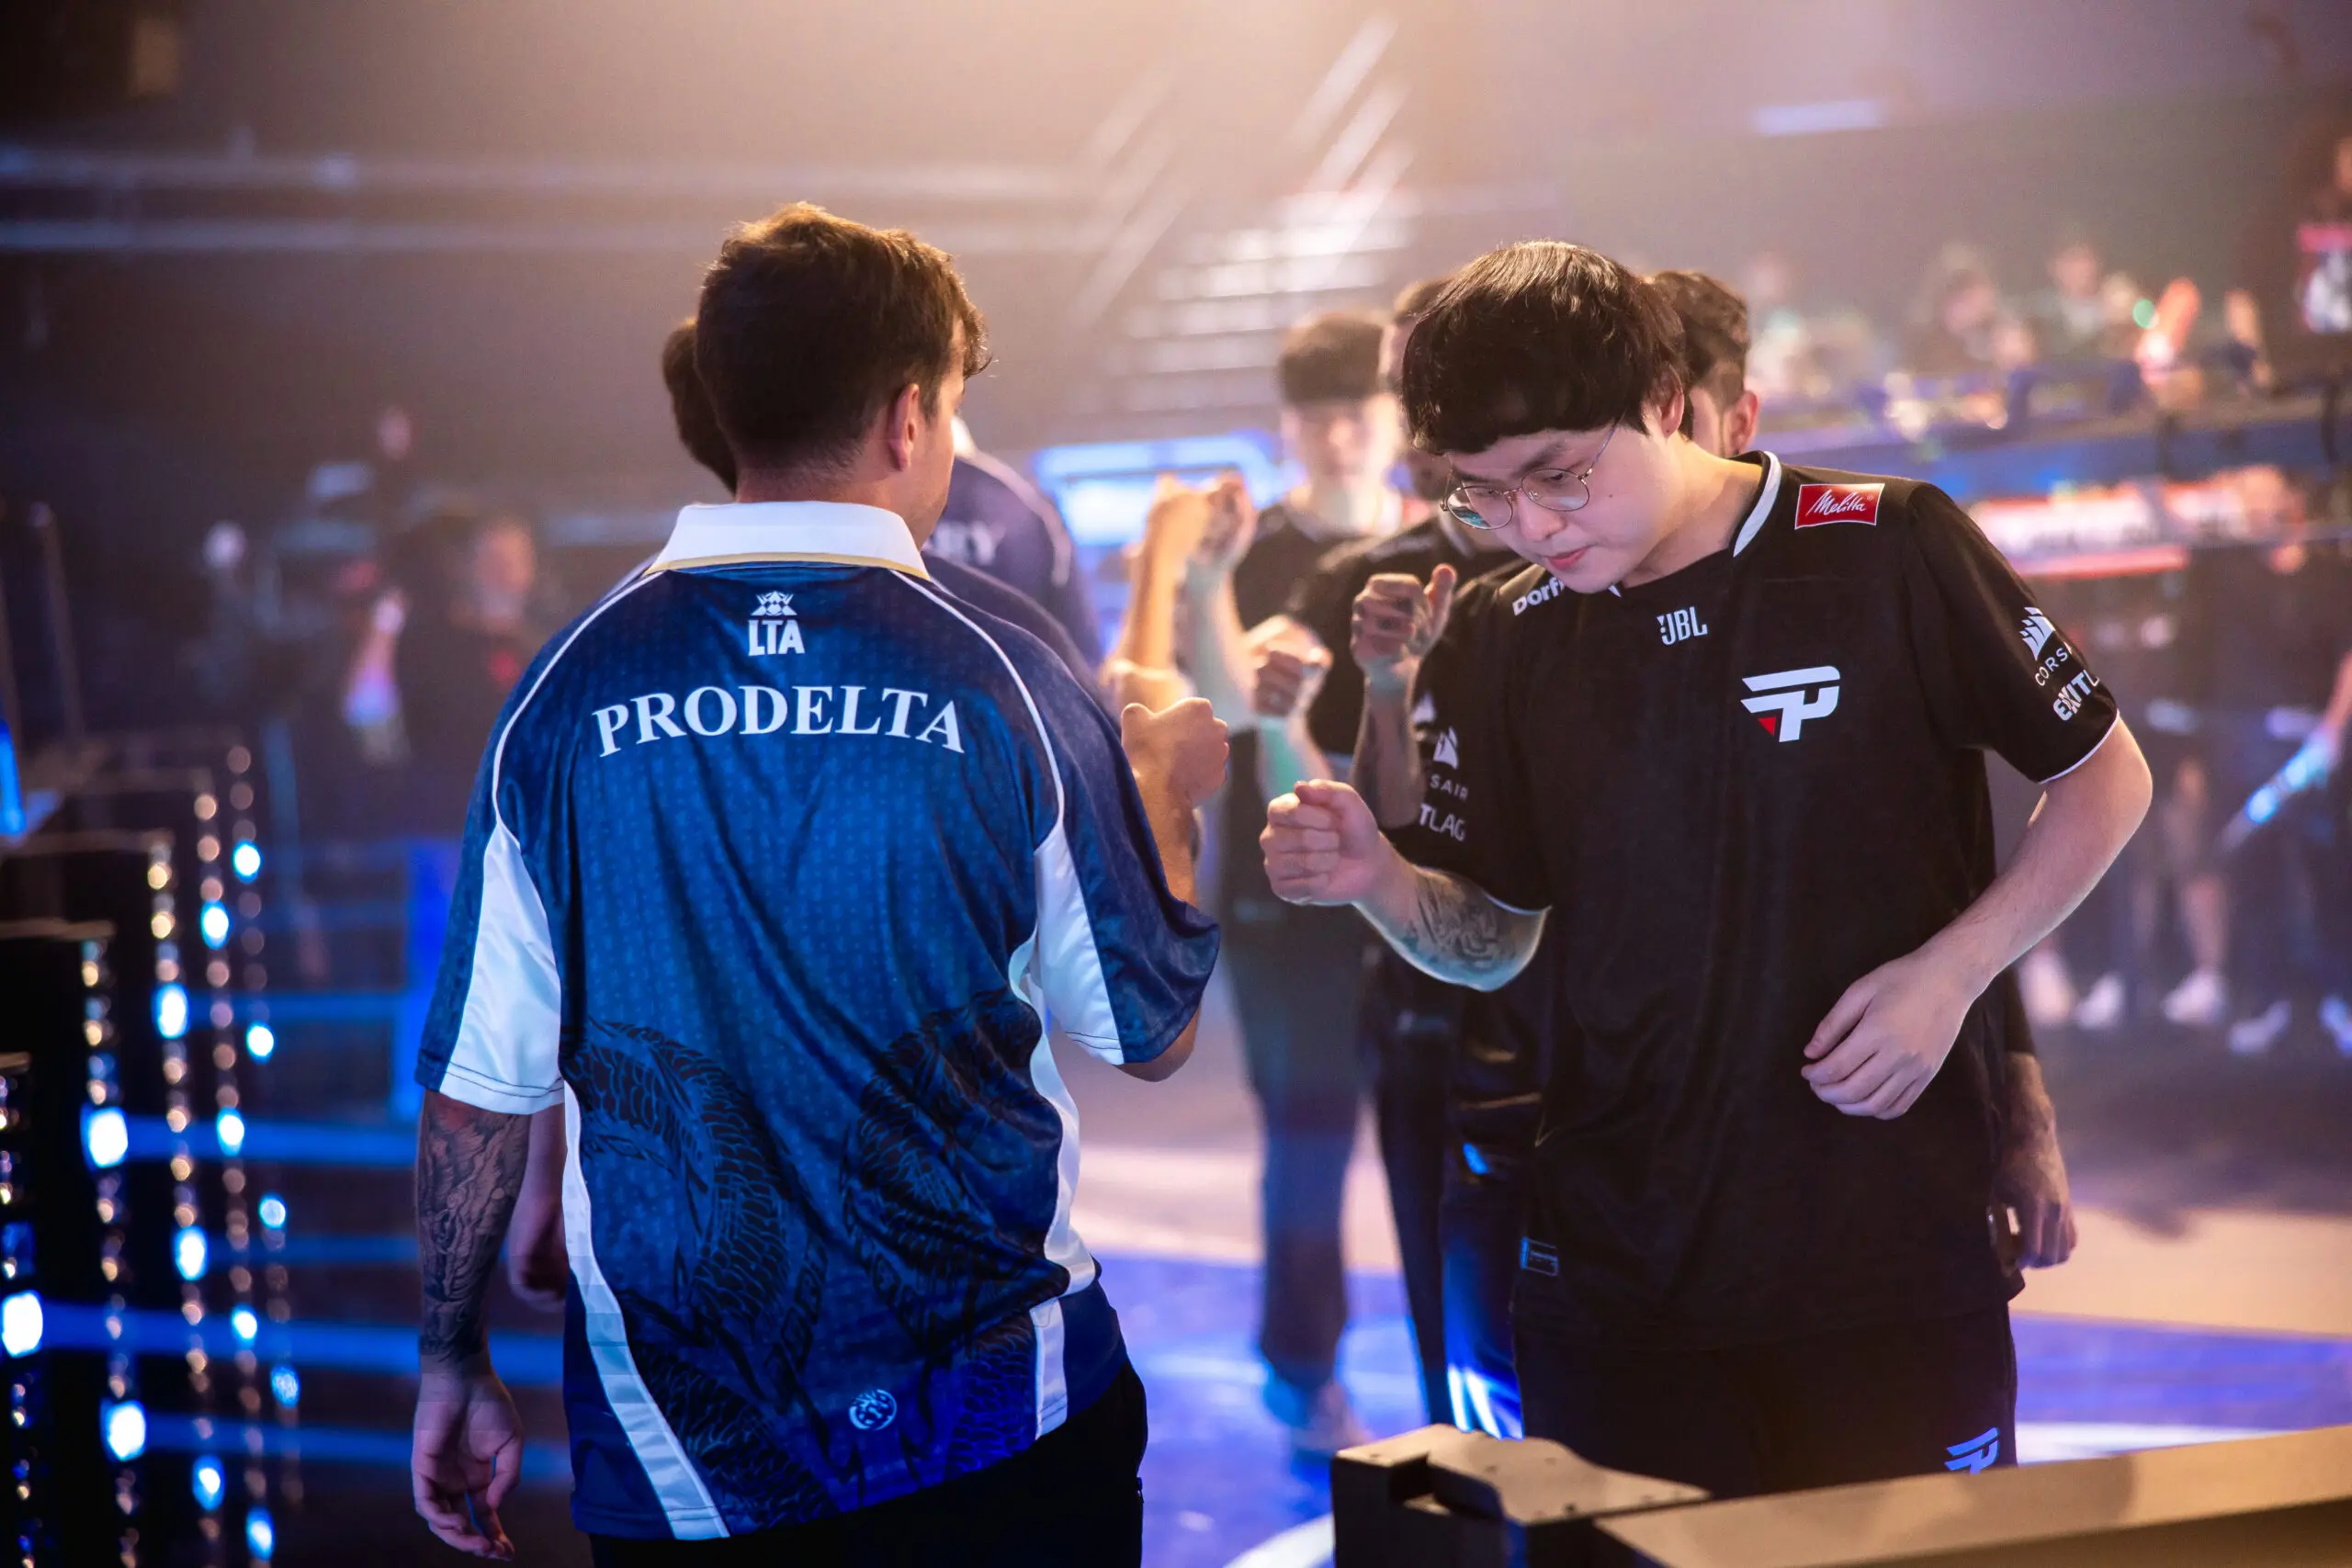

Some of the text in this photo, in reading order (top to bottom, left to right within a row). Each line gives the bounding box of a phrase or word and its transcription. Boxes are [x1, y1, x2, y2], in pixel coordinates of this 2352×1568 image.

[1805, 489, 1867, 516] Melitta
[1512, 576, 1565, 615] Dorf
[746, 619, 805, 656] LTA
[1659, 606, 1708, 645] JBL
[2035, 641, 2073, 686] CORS
[2052, 669, 2100, 721] EXITL
[592, 685, 965, 758] PRODELTA
[1430, 773, 1469, 802] SAIR
[1419, 802, 1466, 841] TLAG
